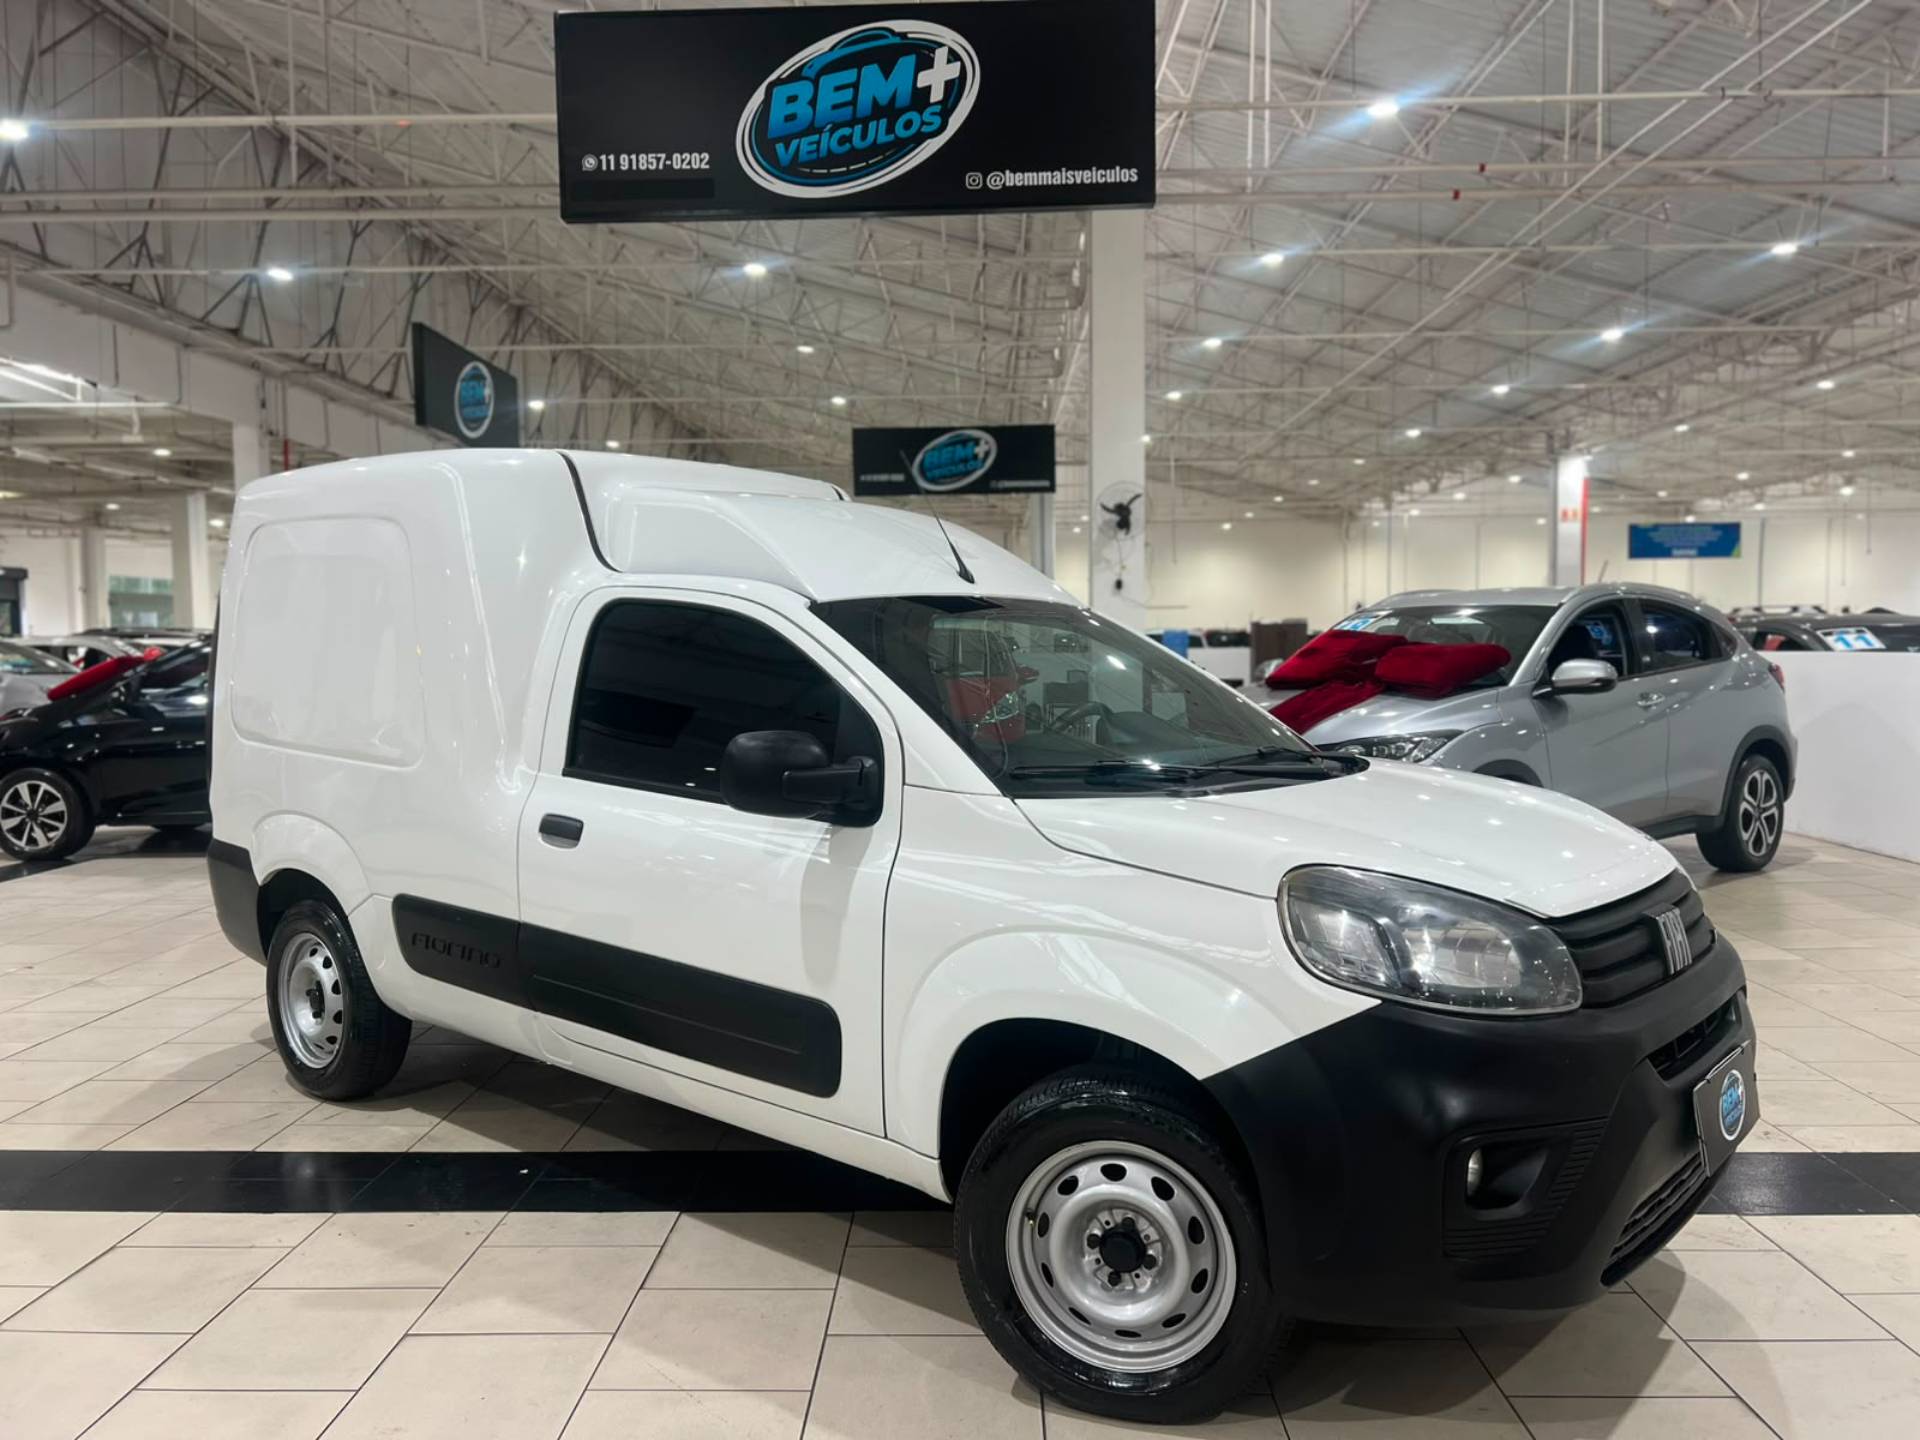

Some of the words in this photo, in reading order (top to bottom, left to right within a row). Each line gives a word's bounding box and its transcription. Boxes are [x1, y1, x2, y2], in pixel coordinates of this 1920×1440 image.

[775, 104, 942, 167] VEÍCULOS
[599, 153, 616, 171] 11
[619, 152, 710, 171] 91857-0202
